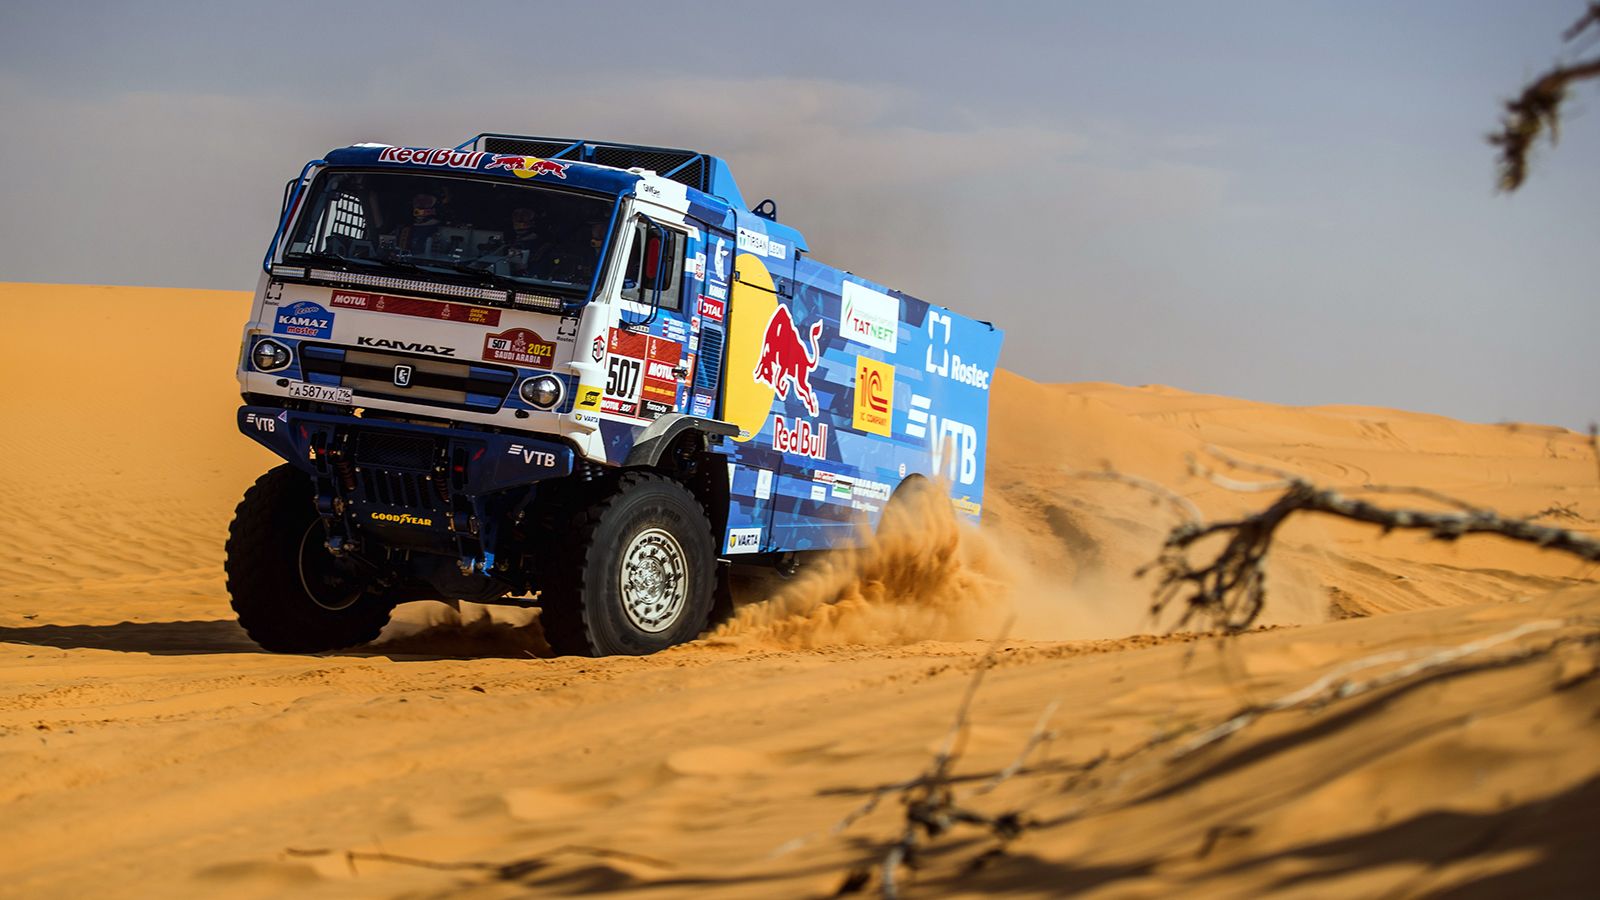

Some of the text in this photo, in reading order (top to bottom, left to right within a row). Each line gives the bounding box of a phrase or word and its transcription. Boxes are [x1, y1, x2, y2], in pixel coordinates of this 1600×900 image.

[378, 147, 485, 169] Red Bull
[334, 294, 366, 306] MOTUL
[698, 298, 722, 317] TOTAL
[278, 315, 329, 329] KAMAZ
[287, 325, 320, 336] master
[853, 318, 895, 343] TATNEFT
[357, 336, 455, 356] KAMAZ
[492, 339, 552, 357] 507 2021
[494, 350, 541, 364] SAUDI ARABIA
[605, 356, 641, 399] 507
[647, 362, 675, 381] MOTUL
[951, 354, 989, 390] Rostec
[255, 417, 275, 432] VTB
[773, 415, 828, 460] Red Bull
[523, 449, 556, 468] VTB
[929, 414, 977, 486] VTB
[371, 512, 432, 526] GOODYEAR
[737, 534, 758, 546] VARTA
